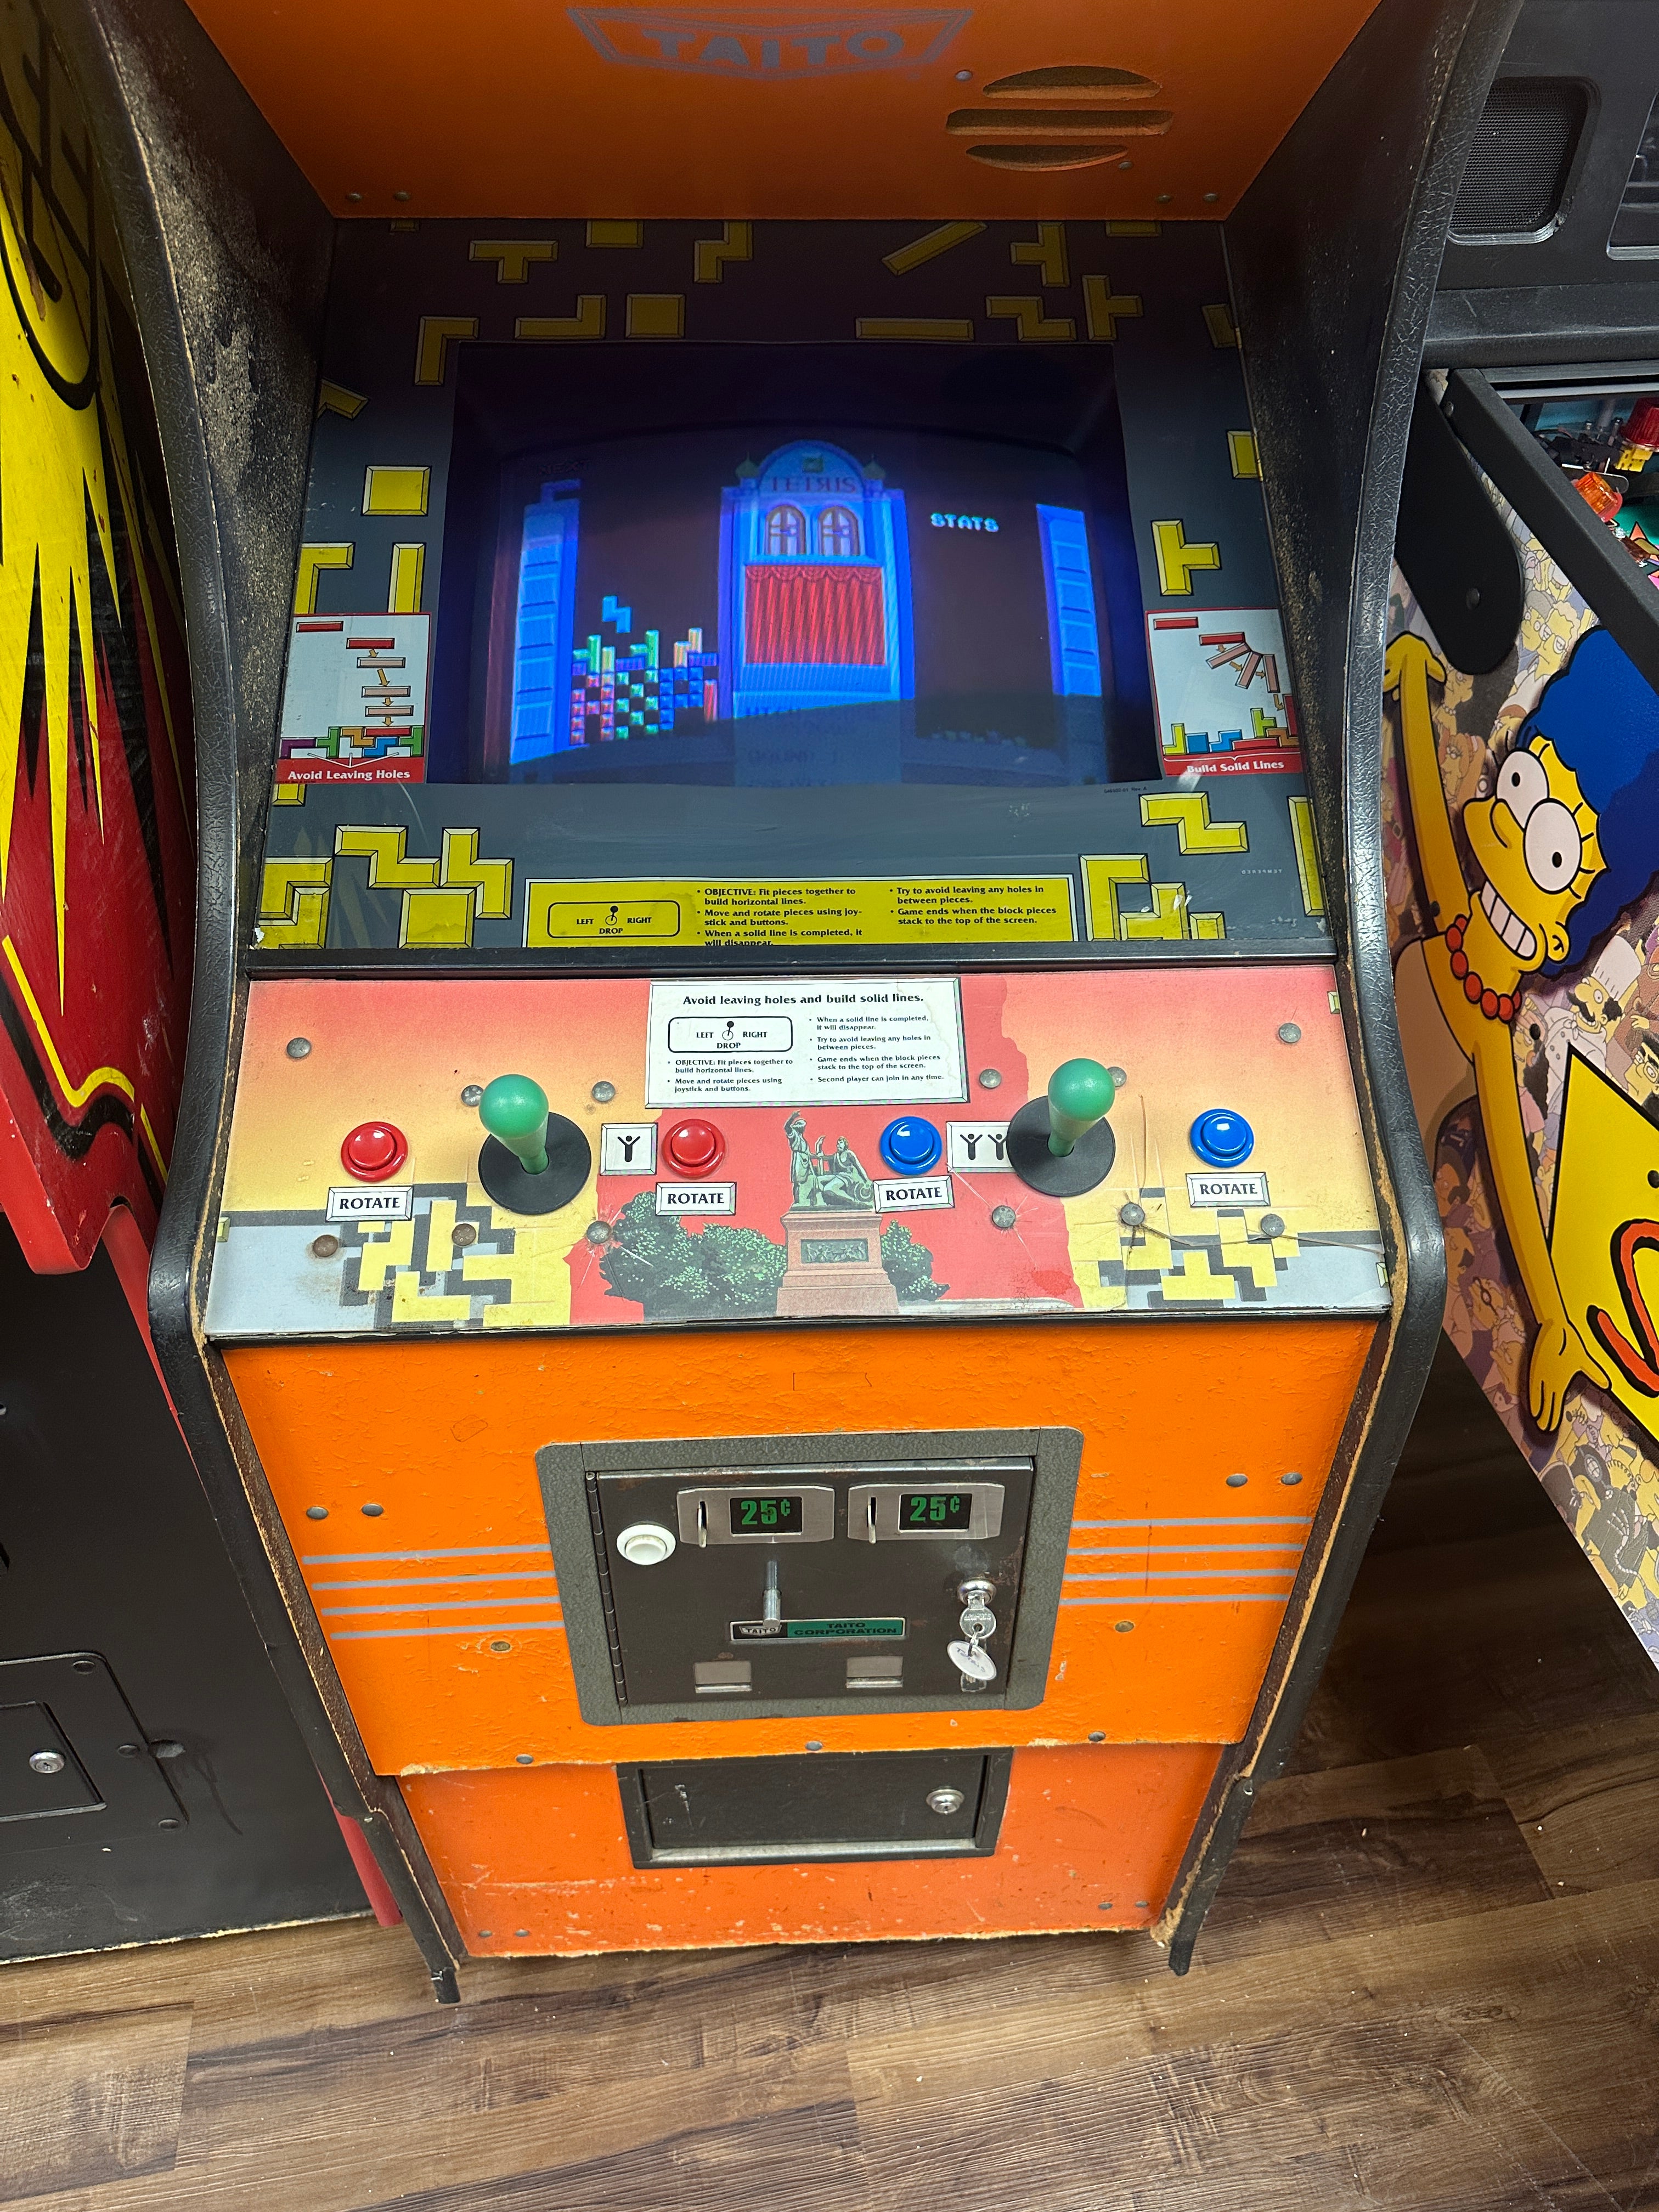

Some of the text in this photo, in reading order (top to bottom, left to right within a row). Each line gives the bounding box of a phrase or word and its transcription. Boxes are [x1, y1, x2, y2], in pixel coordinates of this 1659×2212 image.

[642, 29, 904, 69] TAITO
[930, 512, 1000, 532] STATS
[1187, 761, 1284, 773] Build Solid Lines
[288, 770, 410, 781] Avoid Leaving Holes
[704, 888, 756, 896] OBJECTIVE:
[806, 888, 843, 896] together
[896, 887, 910, 896] Try
[953, 886, 985, 894] leaving
[784, 909, 814, 917] pieces
[845, 908, 862, 916] joy-
[1026, 907, 1057, 915] pieces
[683, 993, 924, 1006] Avoid leaving holes and build solid lines.
[886, 1187, 942, 1201] ROTATE
[1200, 1183, 1257, 1194] ROTATE
[340, 1197, 400, 1209] ROTATE
[668, 1193, 725, 1204] ROTATE
[741, 1499, 791, 1525] 25¢
[910, 1496, 960, 1521] 25¢
